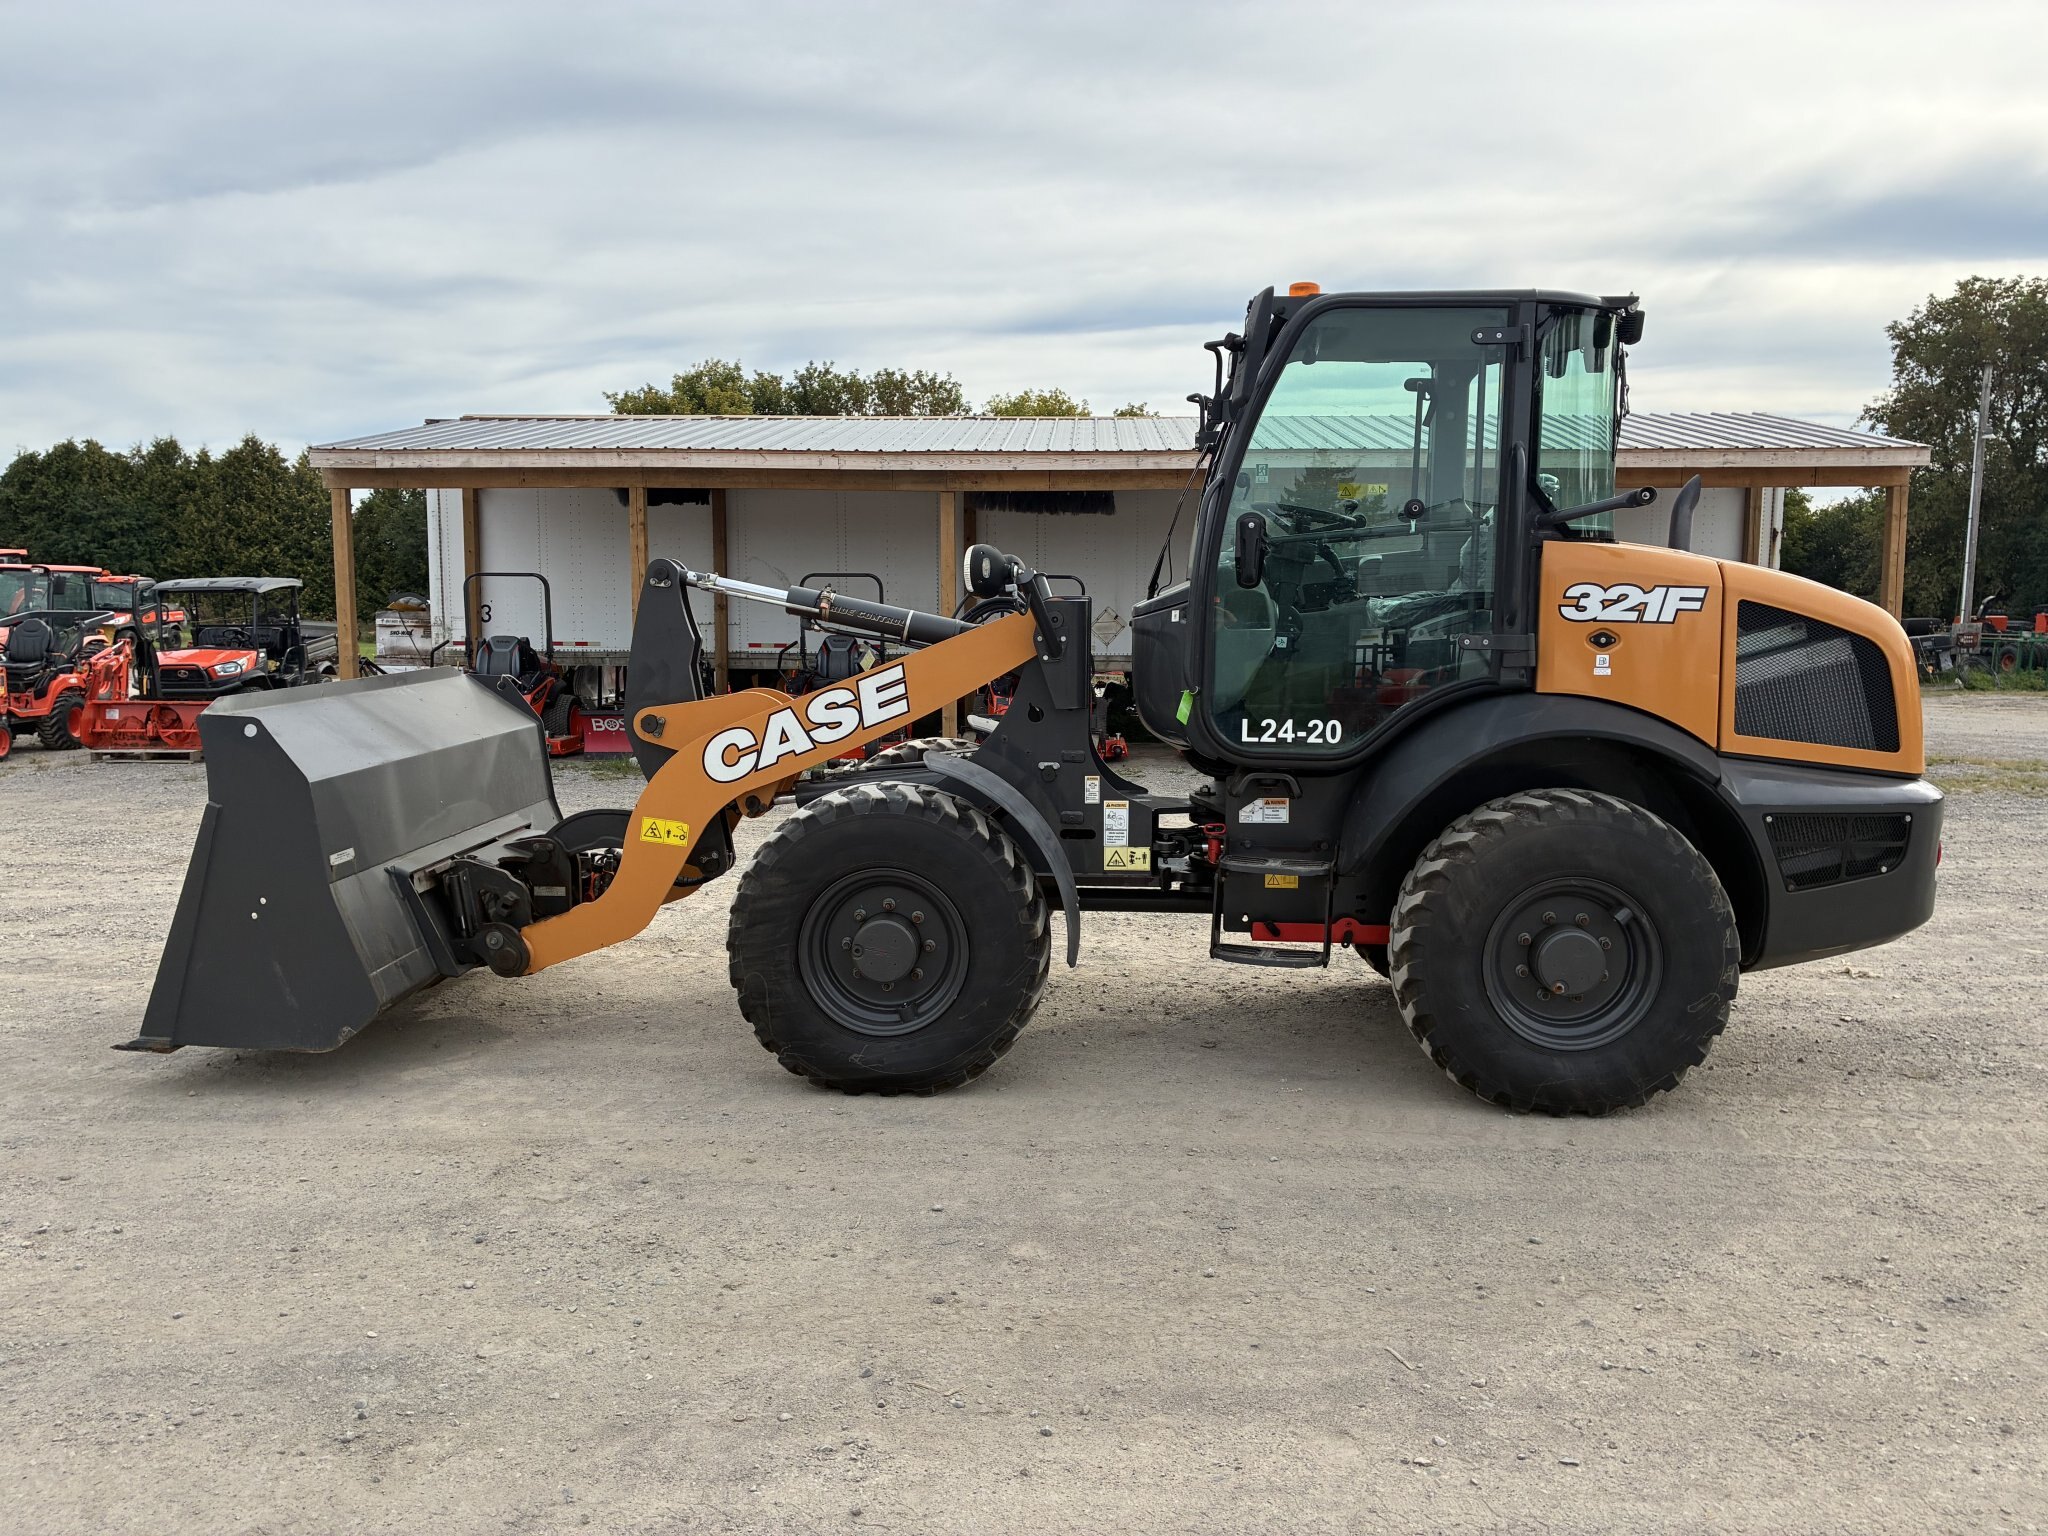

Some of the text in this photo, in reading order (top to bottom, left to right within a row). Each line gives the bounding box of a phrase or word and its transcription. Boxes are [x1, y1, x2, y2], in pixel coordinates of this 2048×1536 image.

[480, 604, 492, 623] 3
[1558, 582, 1709, 624] 321F
[702, 662, 911, 784] CASE
[1241, 718, 1342, 744] L24-20
